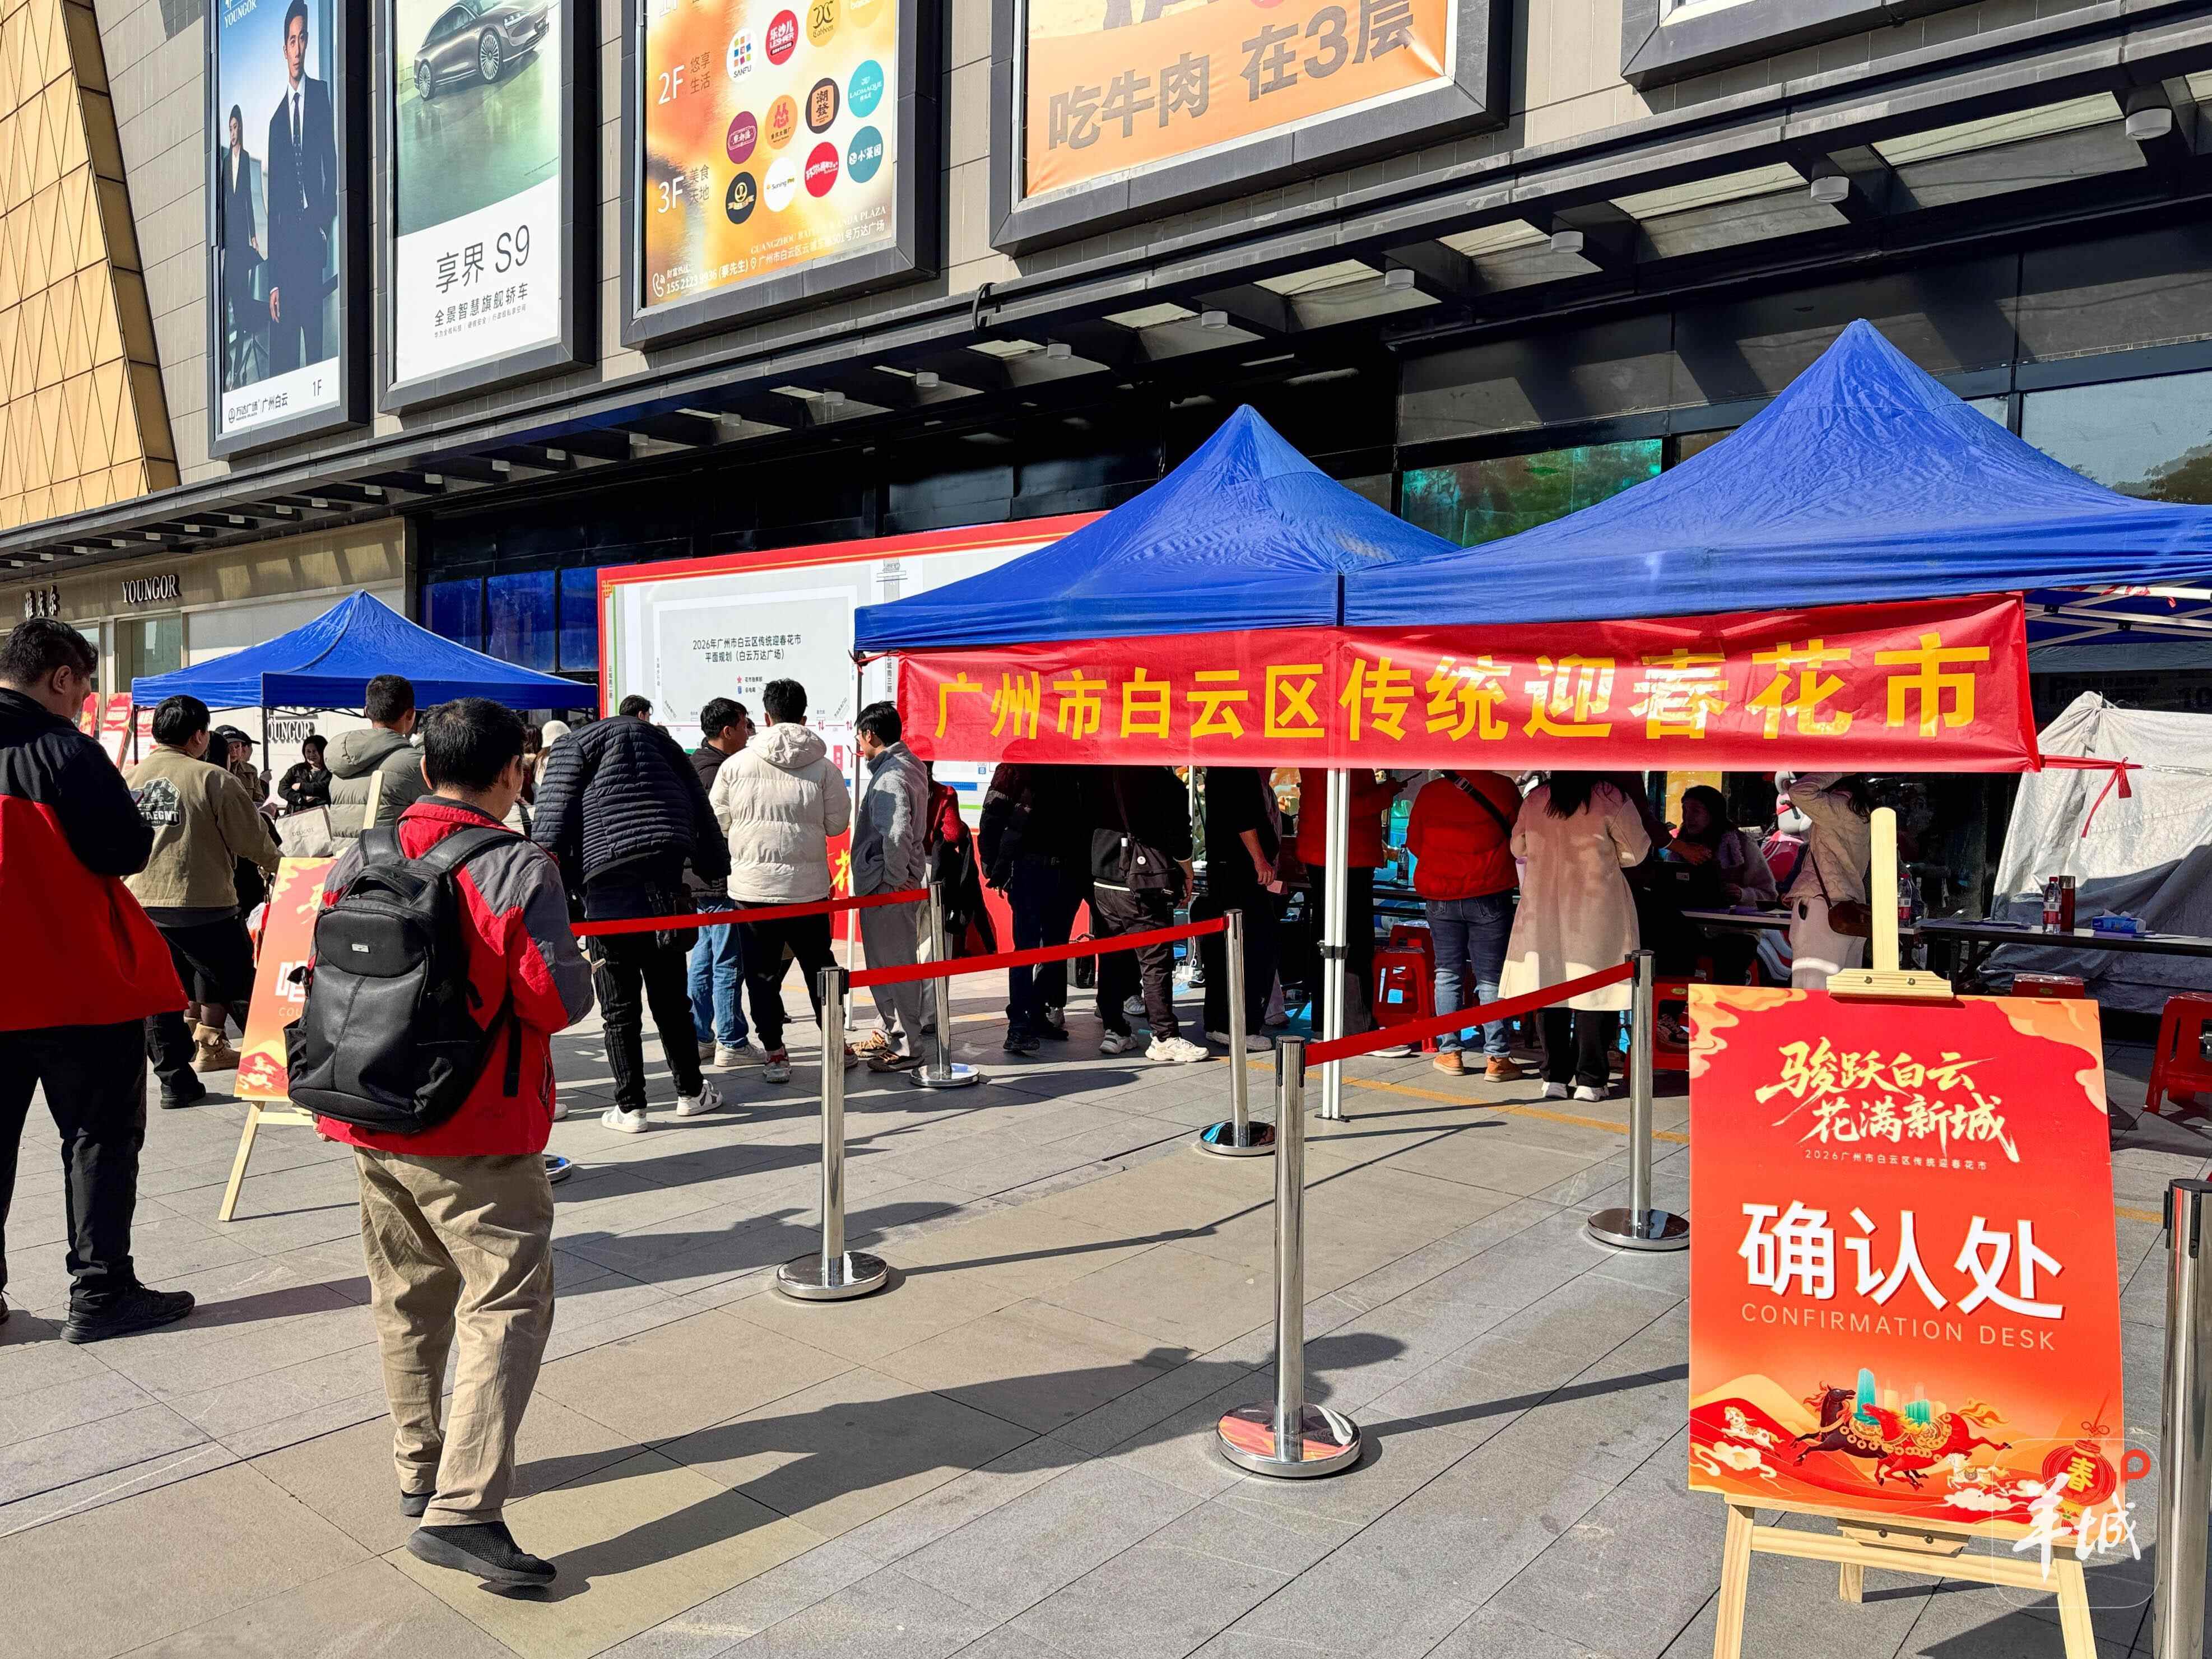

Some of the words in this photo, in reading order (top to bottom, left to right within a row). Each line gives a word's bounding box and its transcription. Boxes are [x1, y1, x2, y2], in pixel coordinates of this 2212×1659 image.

[225, 0, 257, 28] YOUNGOR
[690, 52, 711, 73] 悠享
[733, 65, 752, 78] SANFU
[1048, 51, 1211, 151] 吃牛肉
[1239, 0, 1414, 102] 在3层
[658, 64, 685, 105] 2F
[690, 71, 711, 95] 生活
[689, 164, 709, 183] 美食
[657, 176, 685, 213] 3F
[689, 185, 709, 205] 天地
[860, 206, 886, 221] PLAZA
[436, 242, 485, 294] 享界
[495, 225, 530, 273] S9
[666, 280, 680, 294] 155
[434, 282, 528, 327] 全景智慧旗舰轿车
[313, 379, 322, 397] 1F
[262, 393, 289, 412] 广州白云
[122, 574, 178, 603] YOUNGOR
[693, 634, 801, 650] 2026年广州市白云区传统迎春花市
[934, 631, 1991, 741] 广州市白云区传统迎春花市
[267, 720, 312, 740] OUNGOR
[140, 810, 179, 822] AEGNT
[1755, 1036, 1996, 1126] 骏跃白云
[1796, 1092, 2021, 1163] 花满新城
[1805, 1149, 1988, 1171] 2026广州市白云区传统迎春花市
[1737, 1200, 2066, 1319] 确认处
[1741, 1303, 1963, 1342] CONFIRMATION
[1980, 1326, 2057, 1352] DESK
[2066, 1456, 2094, 1493] 春
